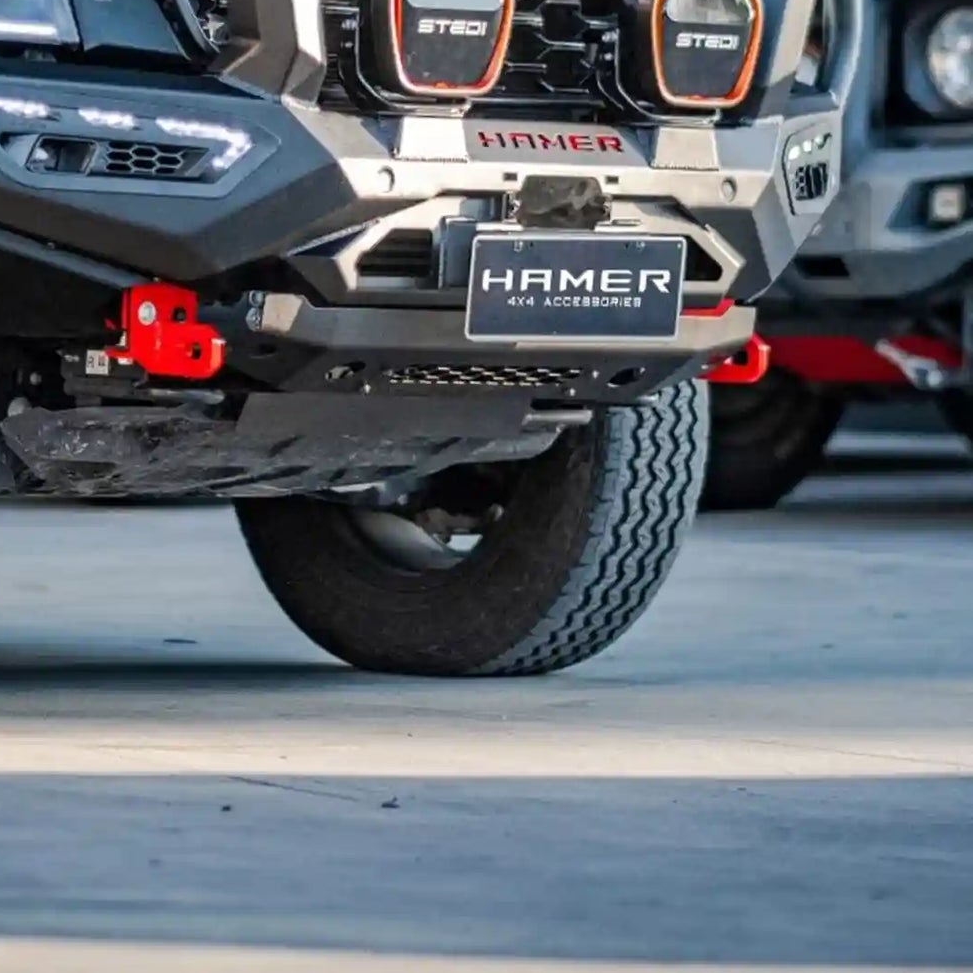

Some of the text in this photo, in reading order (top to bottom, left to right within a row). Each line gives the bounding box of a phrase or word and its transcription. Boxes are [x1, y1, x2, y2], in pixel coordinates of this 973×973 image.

[417, 18, 488, 37] STEDI
[675, 32, 740, 50] STEDI
[477, 131, 625, 153] HAMER
[481, 268, 672, 294] HAMER
[543, 295, 643, 308] ACCESSORIES
